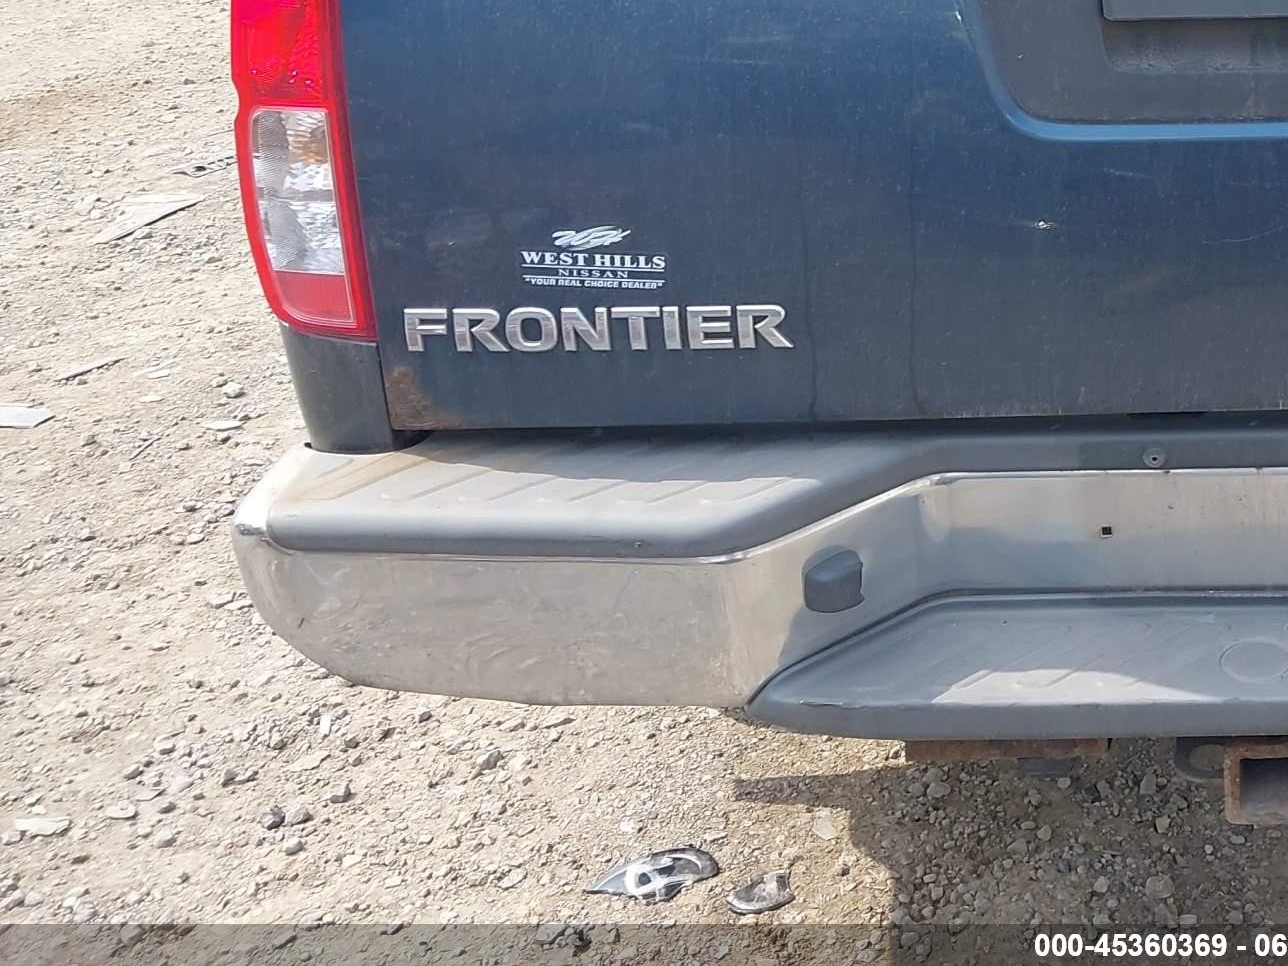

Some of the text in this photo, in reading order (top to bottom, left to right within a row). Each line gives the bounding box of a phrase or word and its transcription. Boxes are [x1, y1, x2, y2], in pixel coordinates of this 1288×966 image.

[520, 251, 666, 268] WEST HILLS
[557, 269, 629, 278] NISSAN
[558, 279, 582, 287] REAL
[584, 280, 619, 288] CHOICE
[403, 303, 794, 353] FRONTIER
